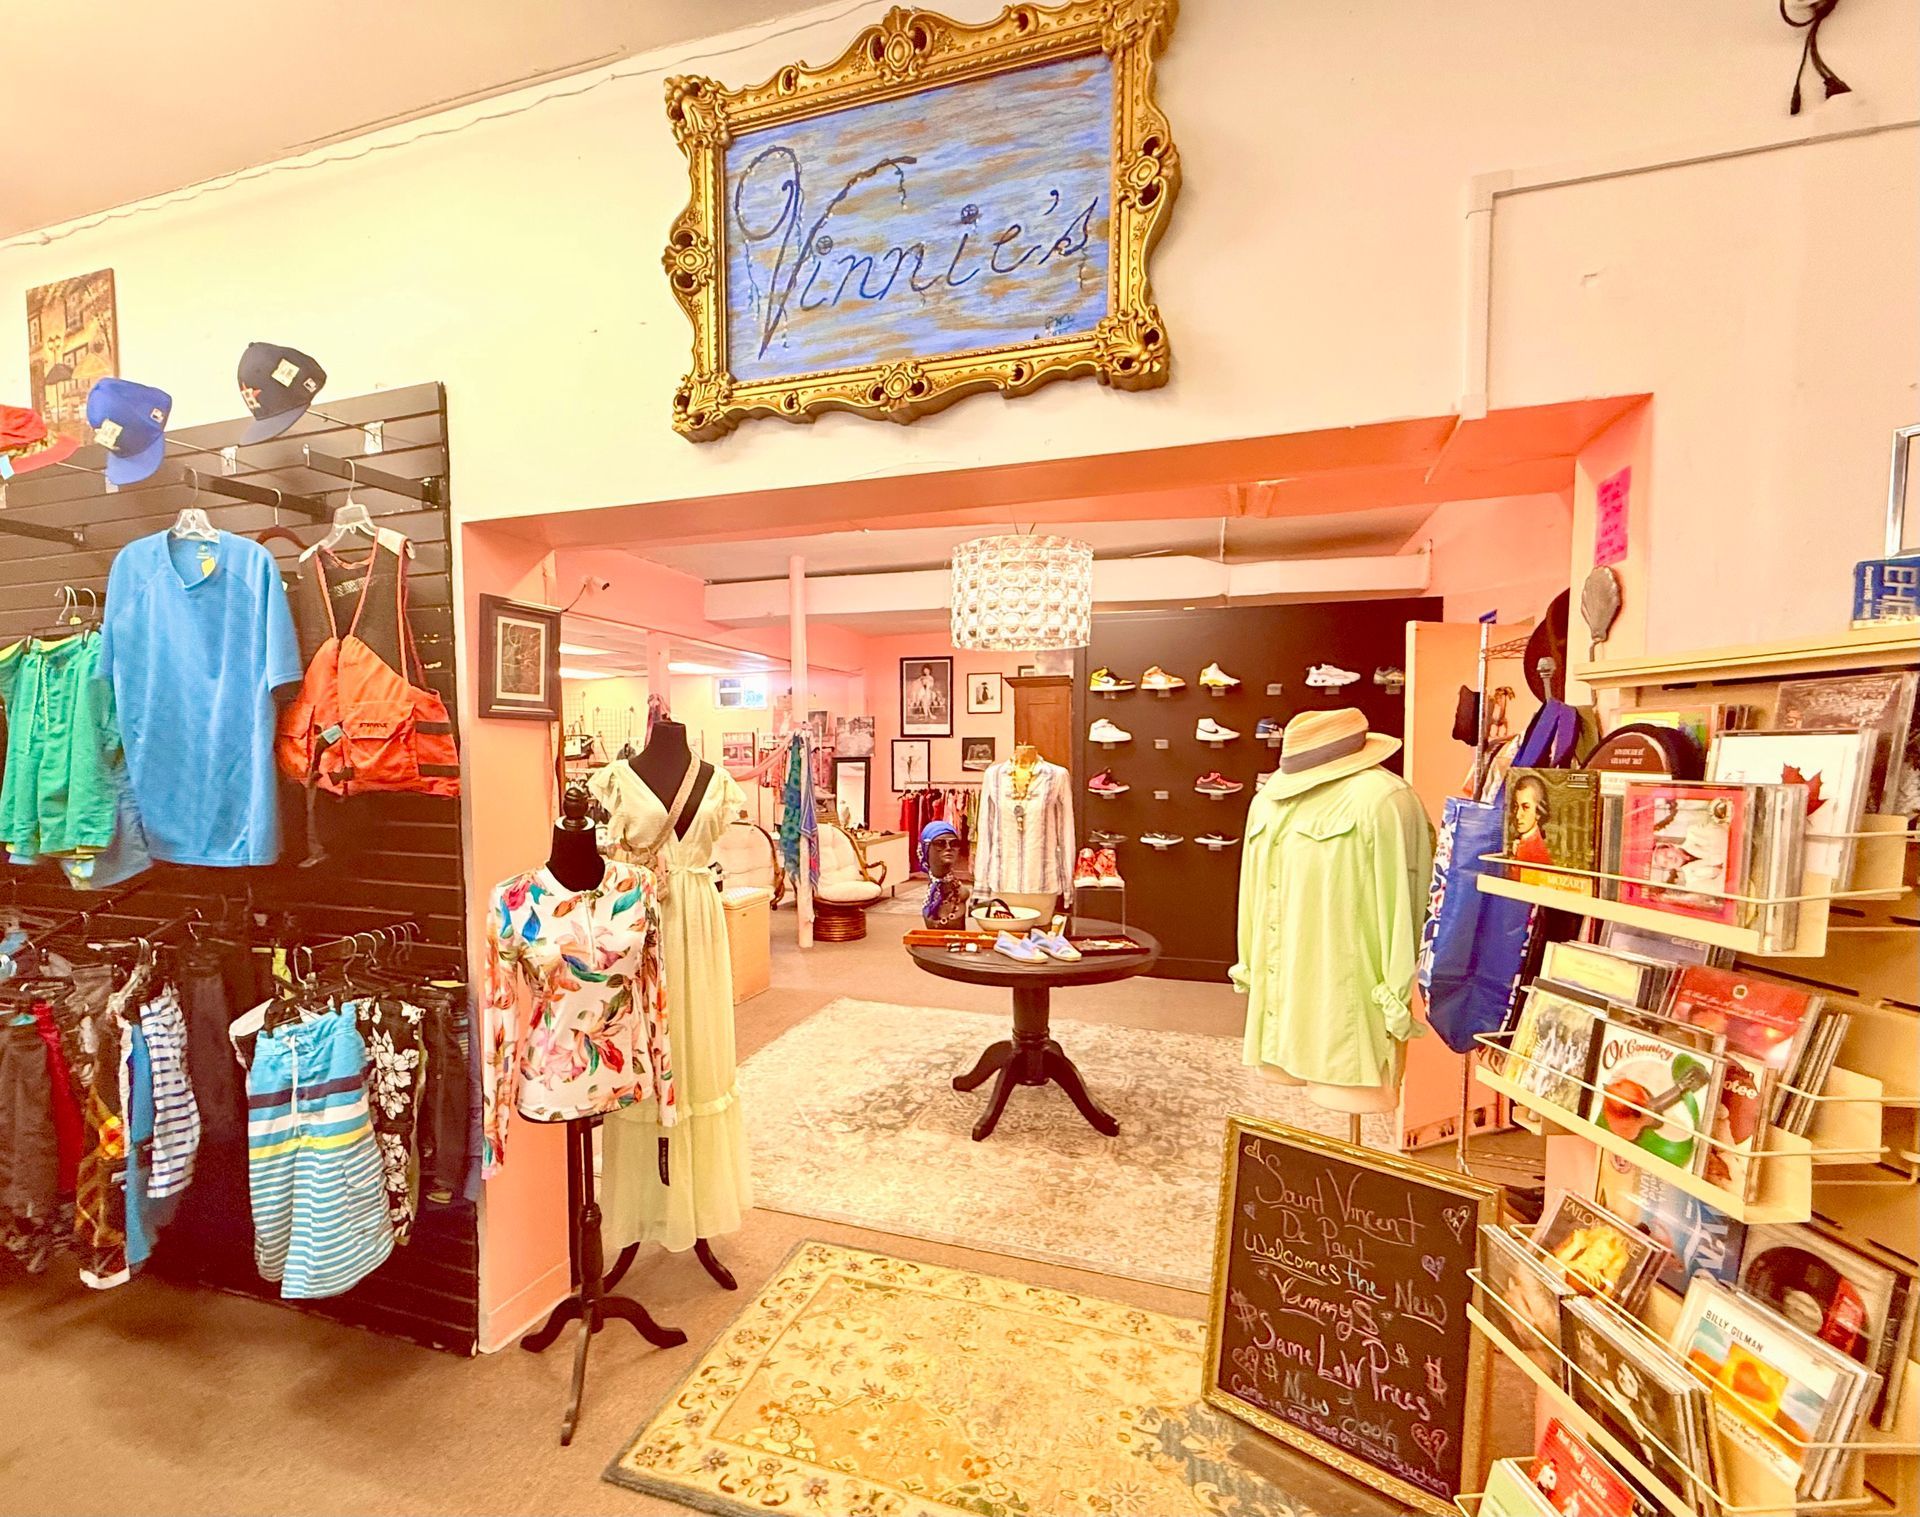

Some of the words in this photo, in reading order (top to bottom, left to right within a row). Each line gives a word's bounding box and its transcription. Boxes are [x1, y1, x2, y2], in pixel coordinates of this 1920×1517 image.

[735, 146, 1099, 361] Vinnie's
[1627, 1039, 1674, 1061] Country
[1255, 1154, 1324, 1214] Saint
[1326, 1169, 1426, 1244] Vincent
[1244, 1228, 1342, 1285] Welcomes
[1343, 1261, 1387, 1300] the
[1395, 1279, 1448, 1327] New
[1253, 1310, 1314, 1366] Same
[1362, 1339, 1431, 1421] Prices
[1705, 1309, 1730, 1330] BILLY
[1731, 1326, 1764, 1353] GILMAN
